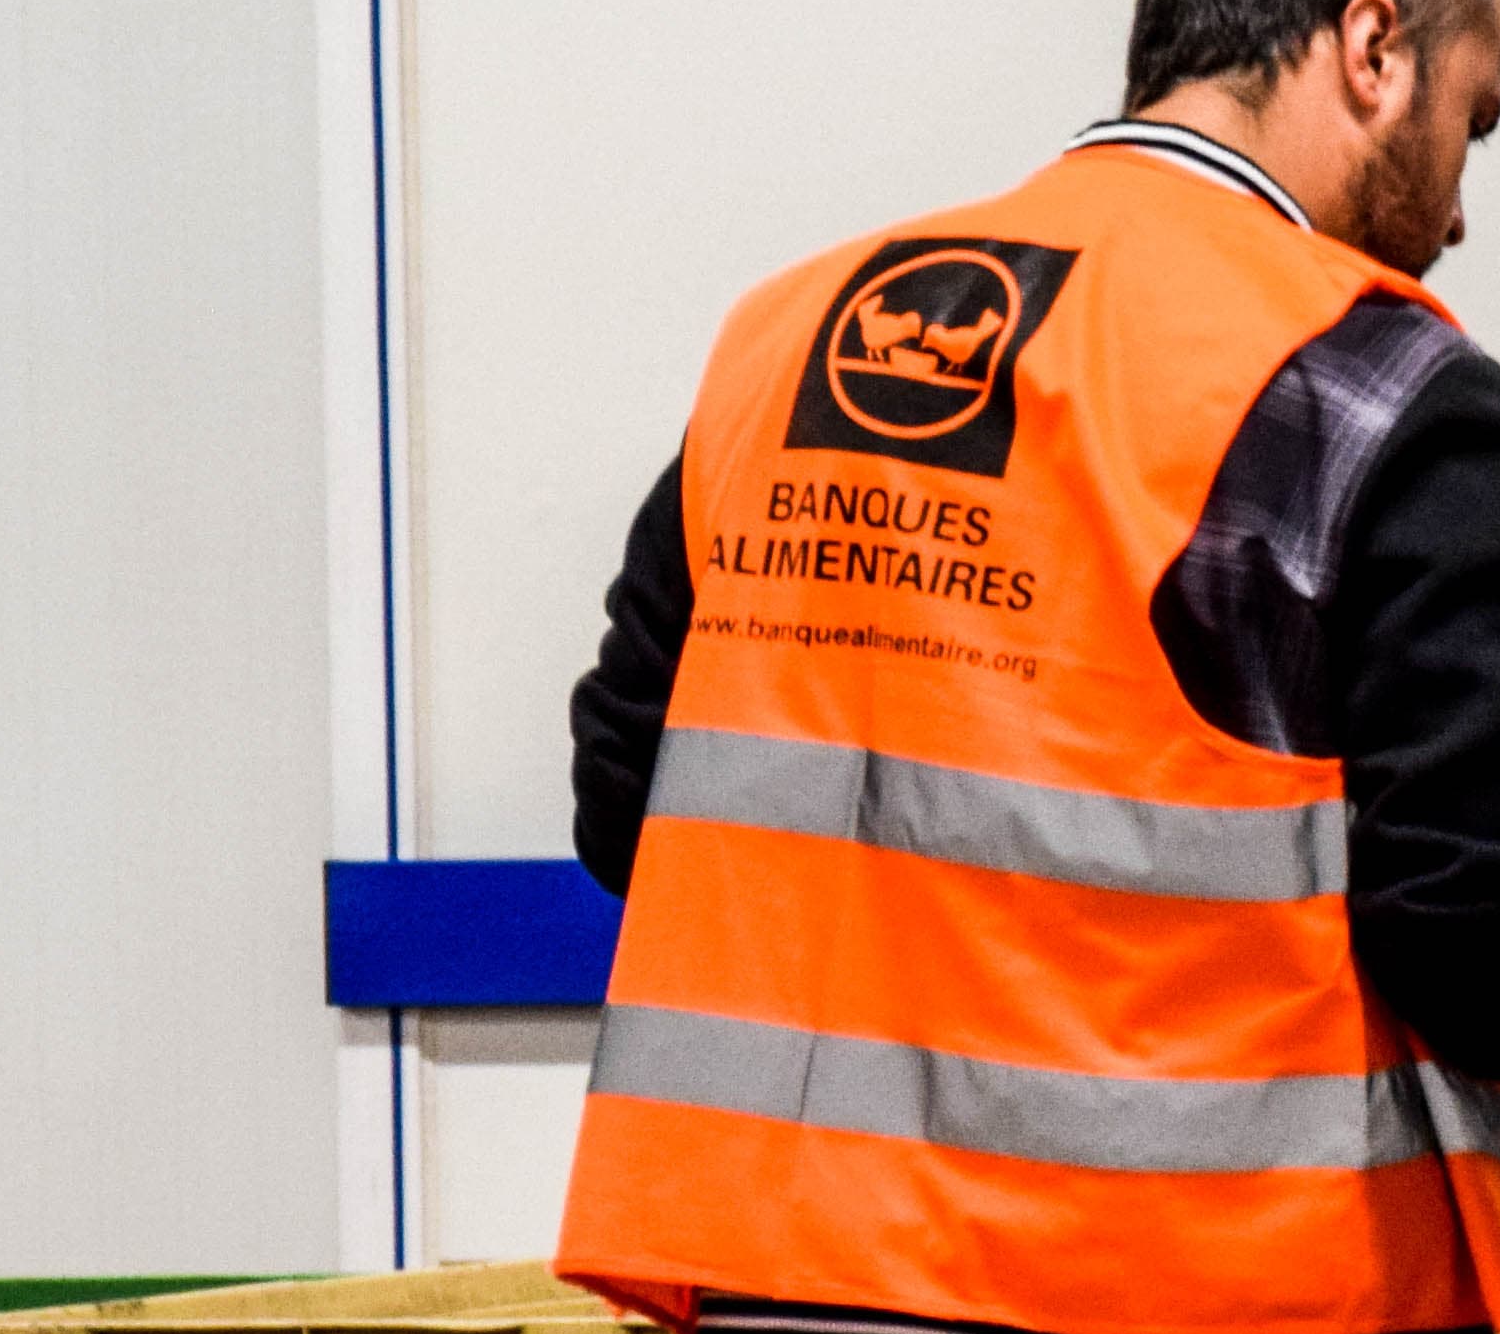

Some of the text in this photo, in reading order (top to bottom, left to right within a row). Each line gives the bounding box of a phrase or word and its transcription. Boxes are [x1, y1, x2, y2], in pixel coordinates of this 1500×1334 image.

[767, 481, 993, 548] BANQUES
[706, 534, 1037, 612] ALIMENTAIRES
[690, 613, 1039, 680] ww.banquealimentaire.org
